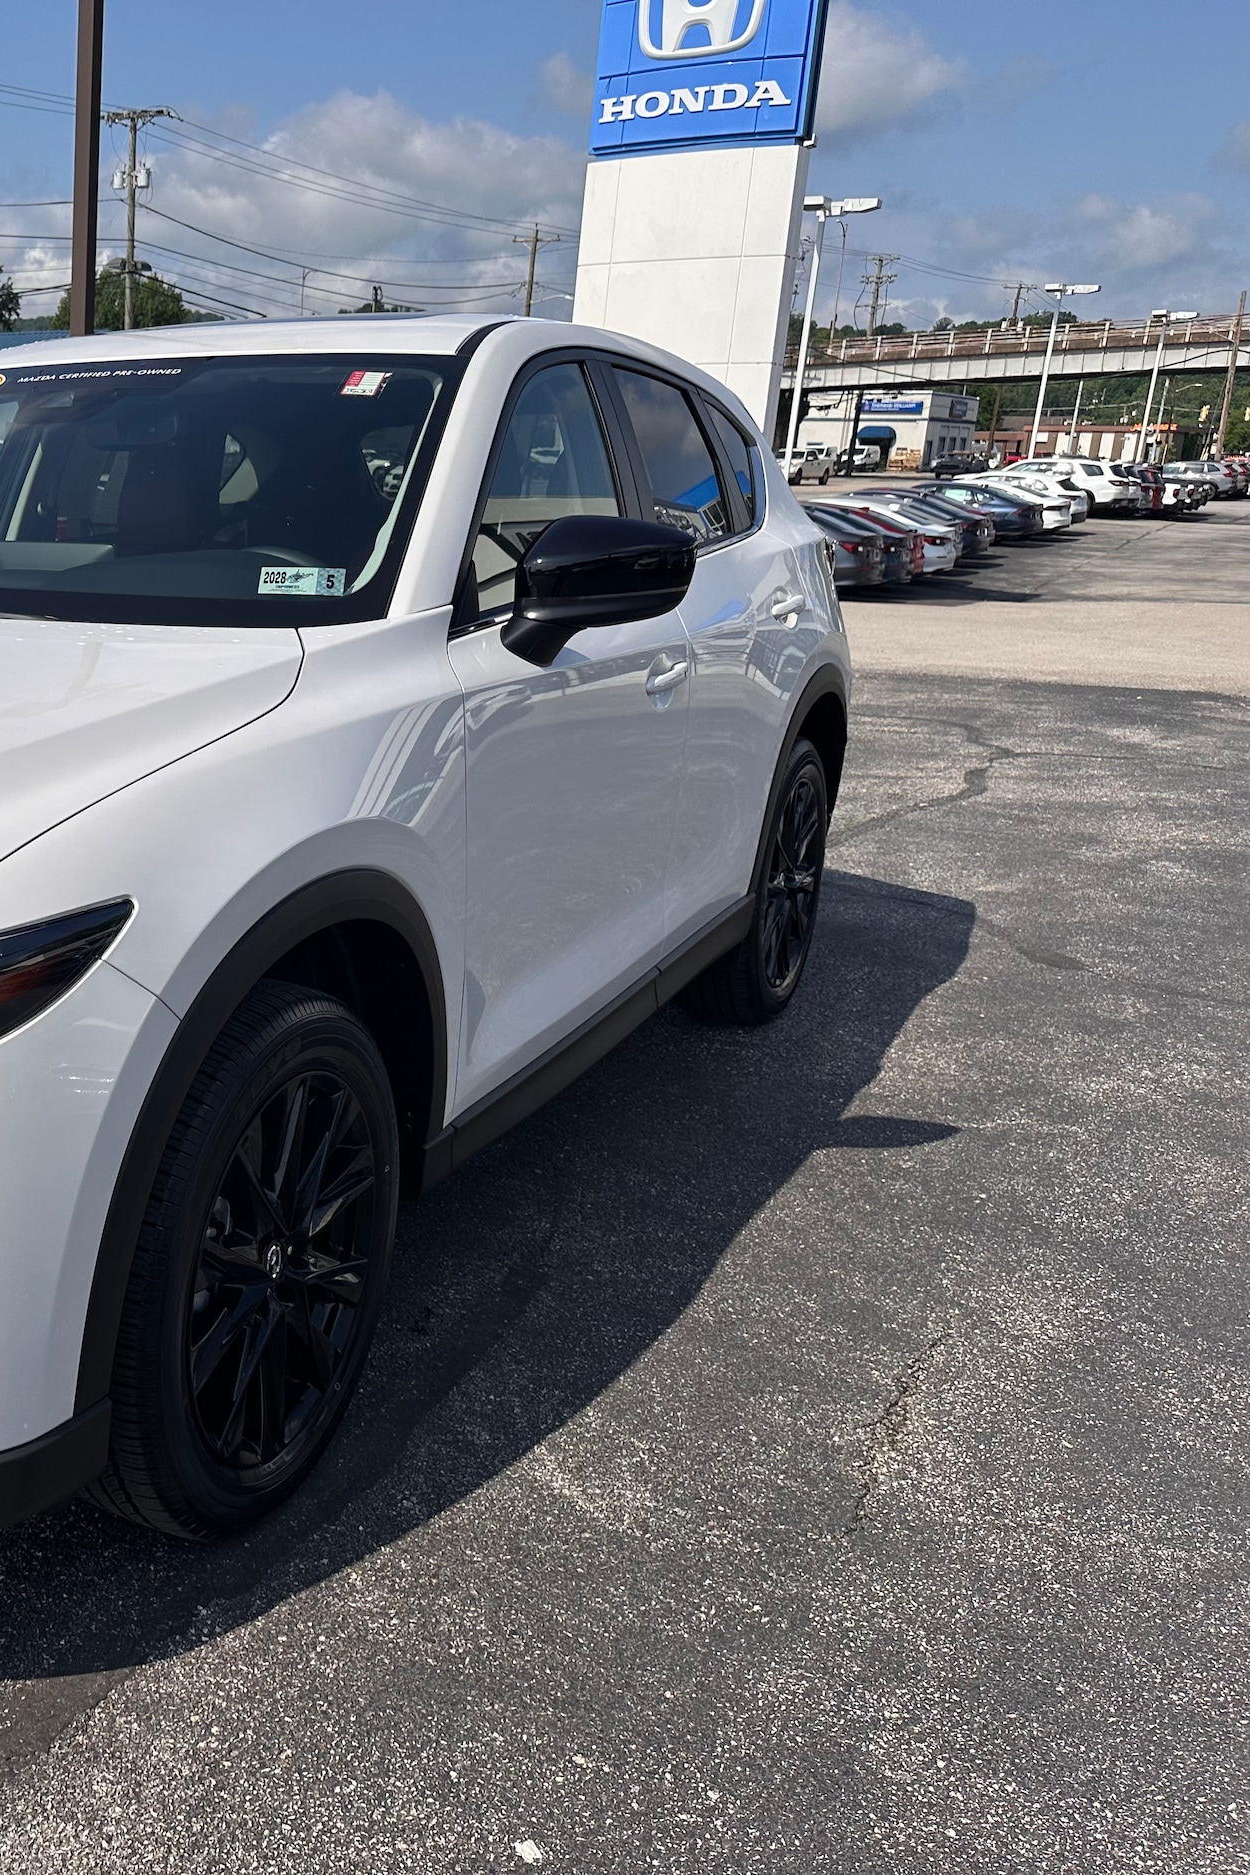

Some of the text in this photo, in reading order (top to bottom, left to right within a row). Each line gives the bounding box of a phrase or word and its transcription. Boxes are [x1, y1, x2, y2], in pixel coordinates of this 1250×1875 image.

[599, 80, 791, 123] HONDA
[16, 368, 182, 383] MAZDA CERTIFIED PRE-OWNED
[263, 571, 336, 589] 2028 5
